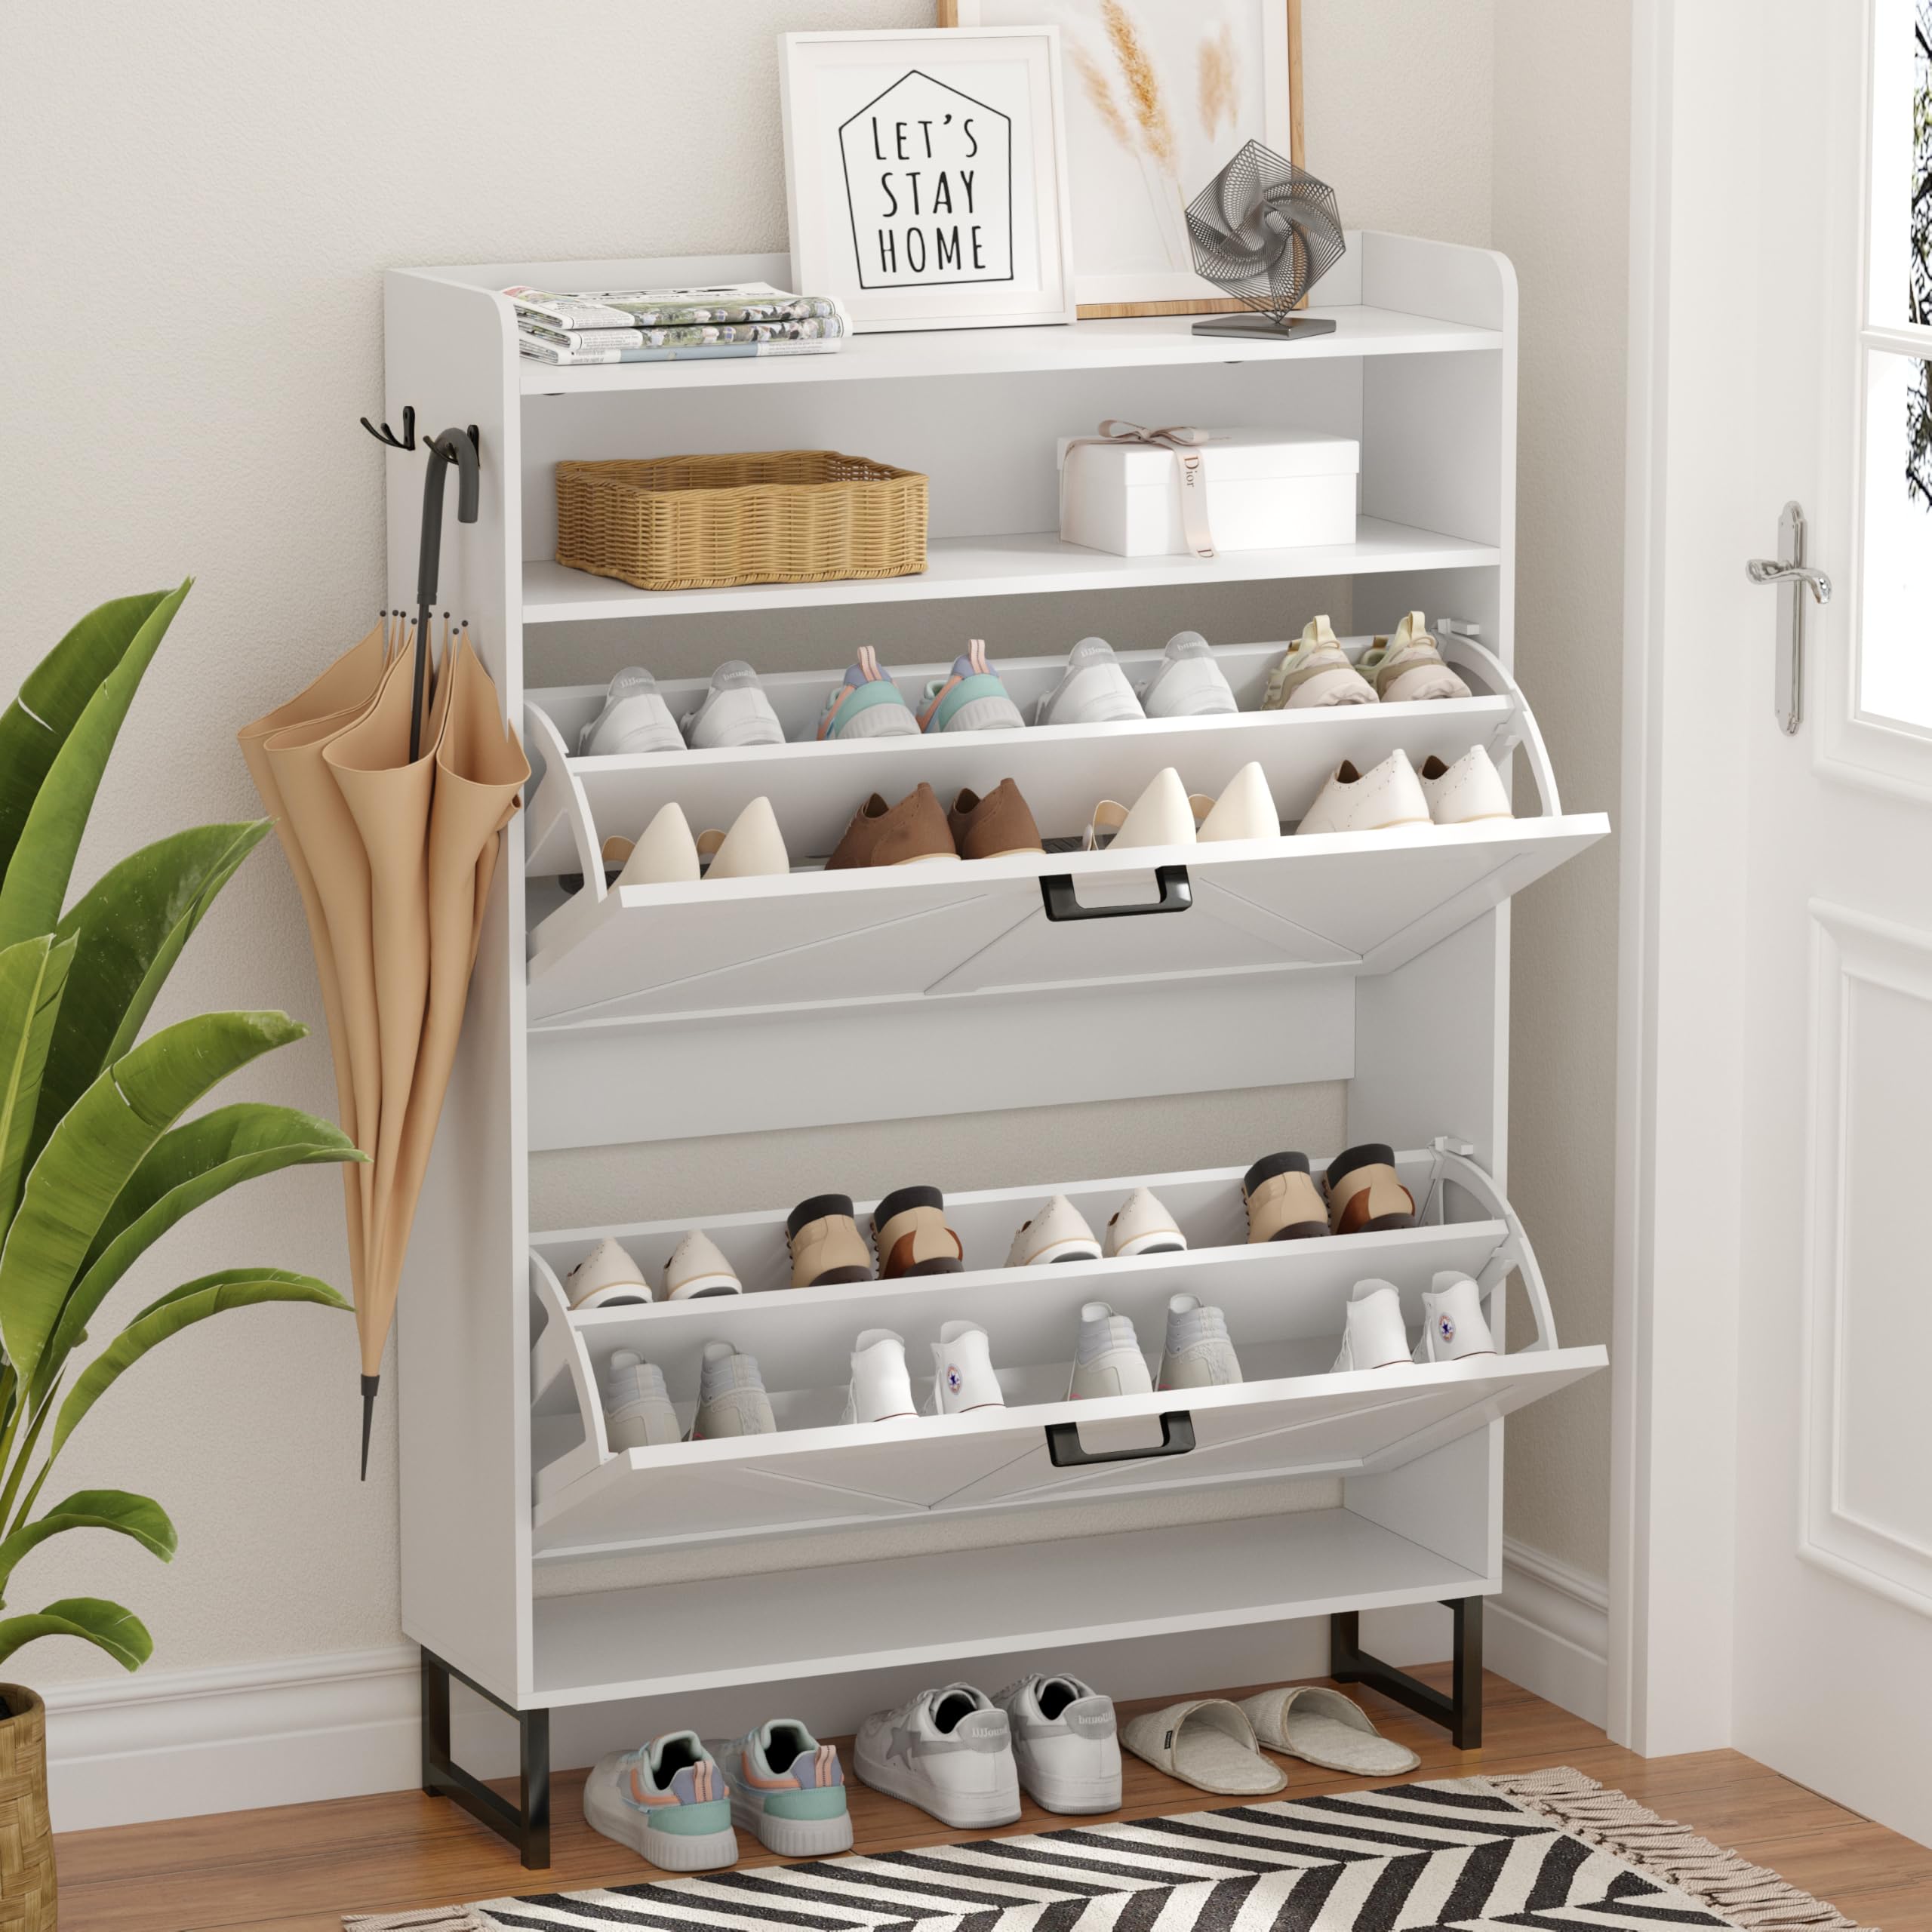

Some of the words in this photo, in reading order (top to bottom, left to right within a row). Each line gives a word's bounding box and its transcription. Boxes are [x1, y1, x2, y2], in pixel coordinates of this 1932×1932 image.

[872, 113, 978, 160] LET'S
[881, 170, 974, 217] STAY
[878, 225, 986, 272] HOME
[1183, 456, 1200, 488] Dior
